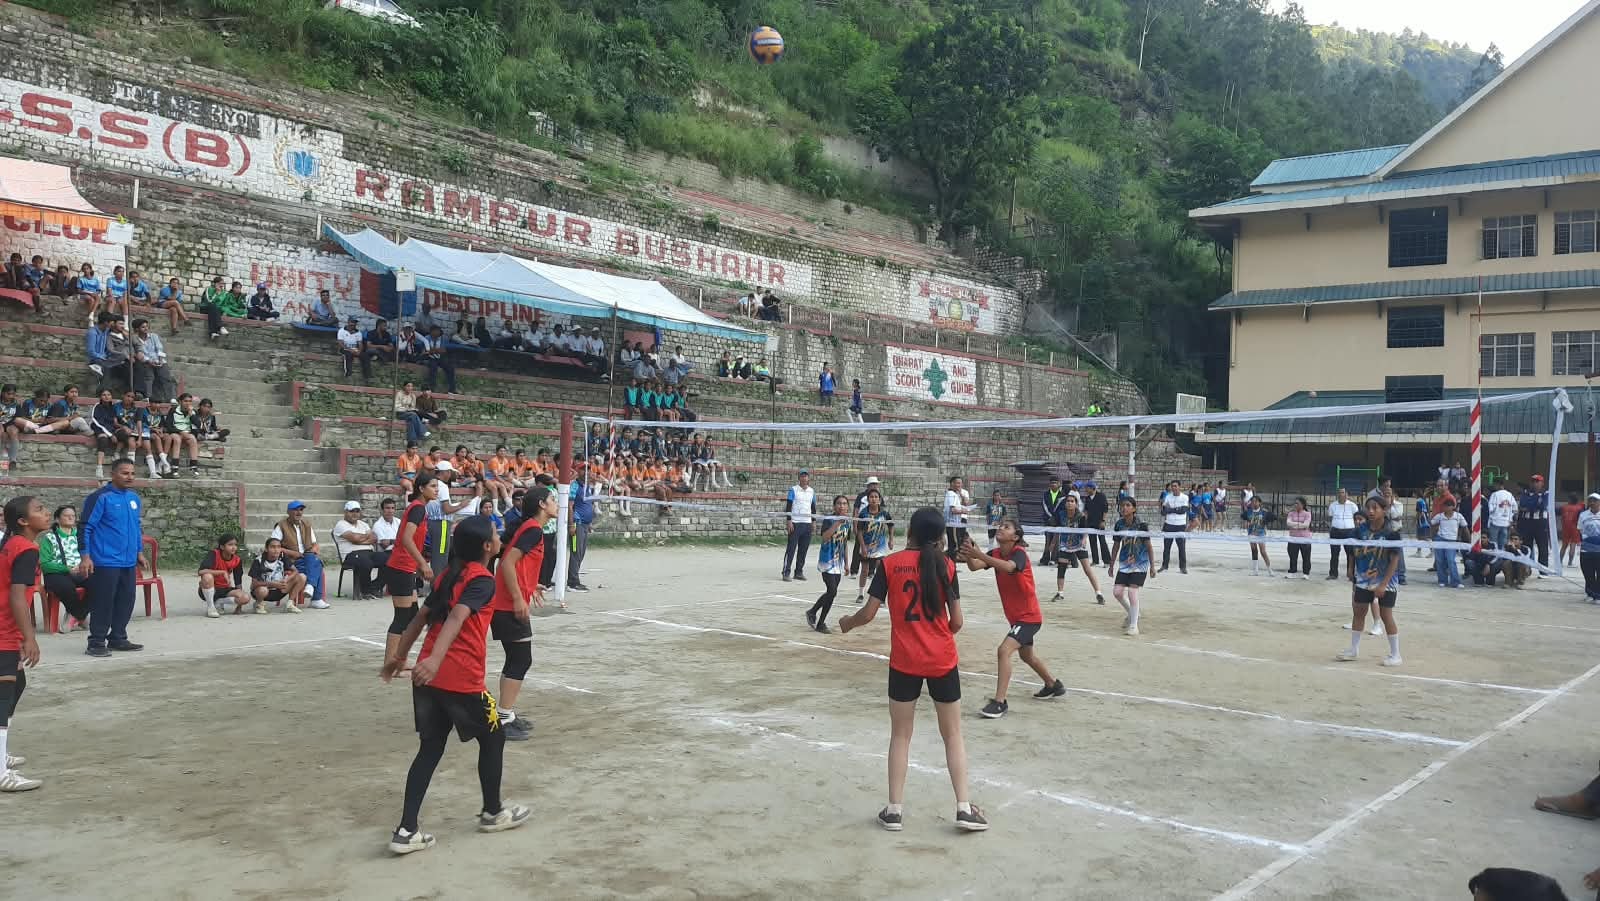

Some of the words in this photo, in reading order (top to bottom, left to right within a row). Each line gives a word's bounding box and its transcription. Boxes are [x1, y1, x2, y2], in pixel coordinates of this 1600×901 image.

[355, 168, 592, 246] RAMPUR
[614, 228, 786, 285] BUSHAHR
[250, 262, 354, 299] UNITY
[283, 300, 312, 316] AN
[423, 287, 552, 325] DISCIPLINE
[892, 354, 923, 371] BHARAT
[952, 365, 968, 377] AND
[895, 373, 921, 387] SCOUT
[950, 383, 974, 395] GUIDE
